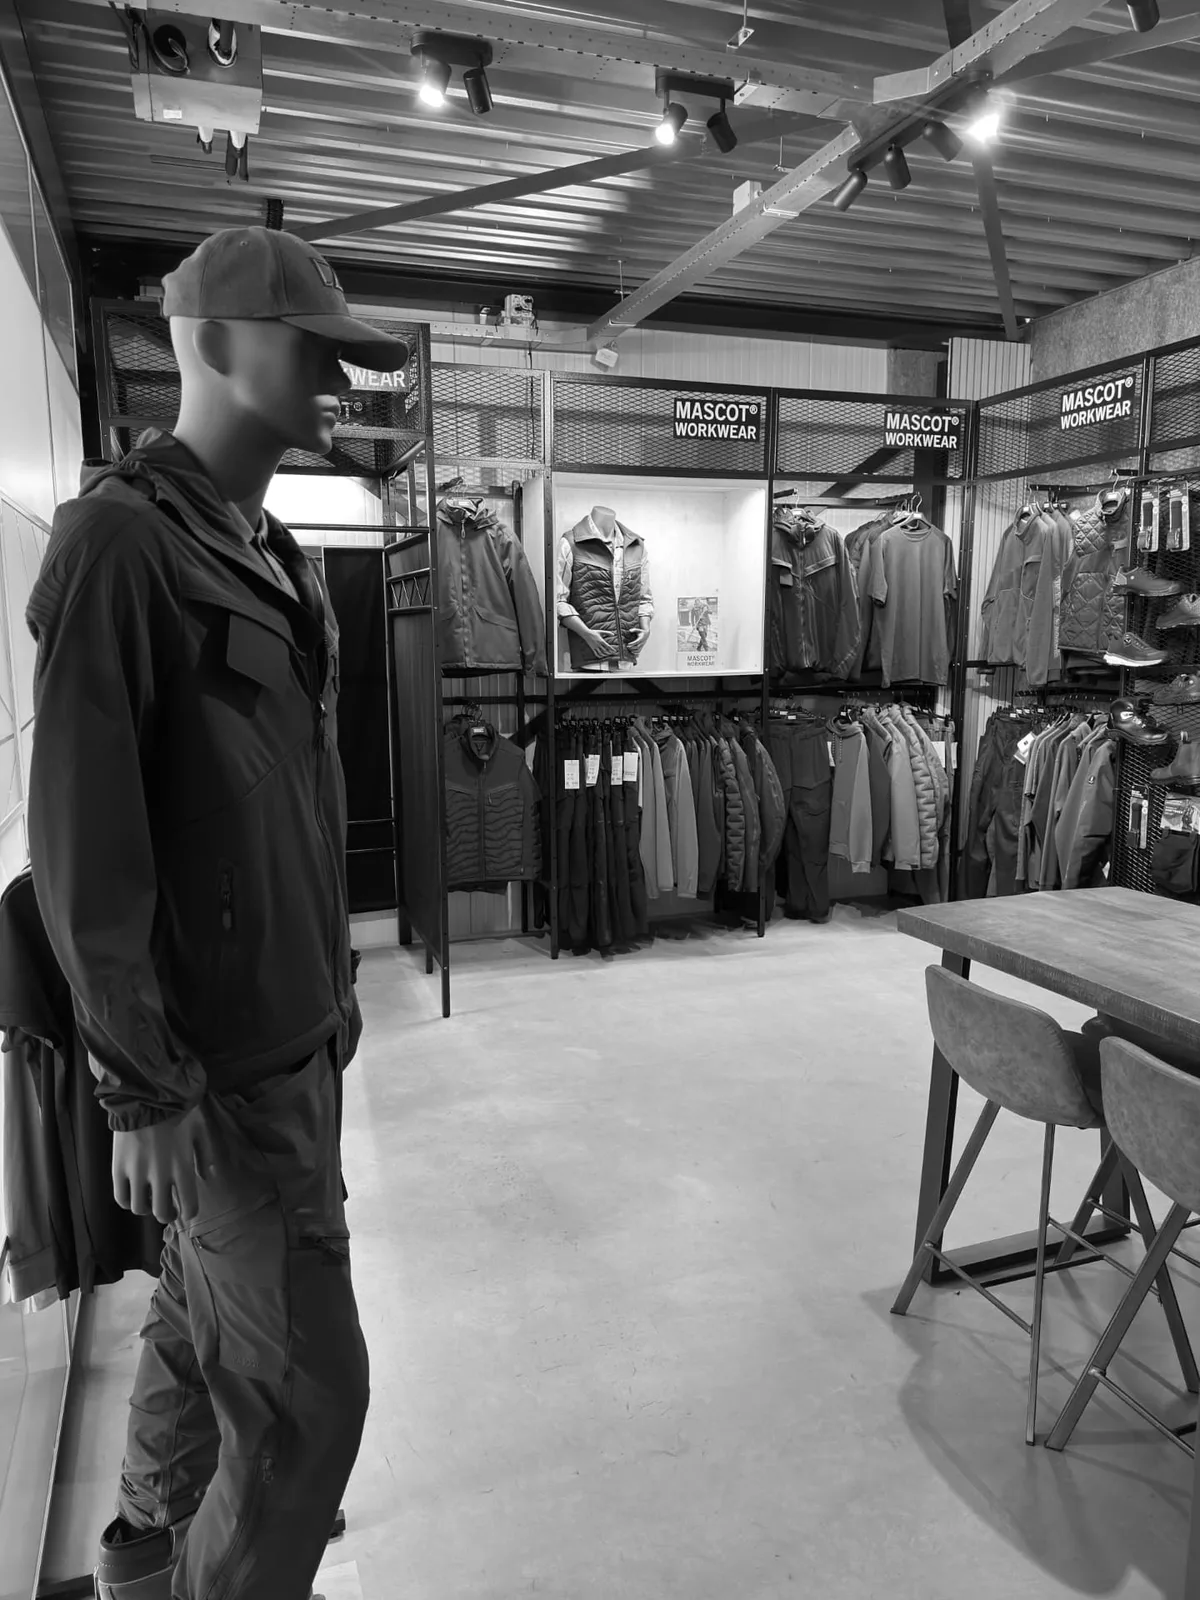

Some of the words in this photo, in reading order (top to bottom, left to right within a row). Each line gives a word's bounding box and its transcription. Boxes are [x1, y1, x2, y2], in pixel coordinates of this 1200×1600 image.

[1061, 400, 1131, 430] WORKWEAR
[675, 421, 756, 440] WORKWEAR
[885, 431, 957, 449] WORKWEAR
